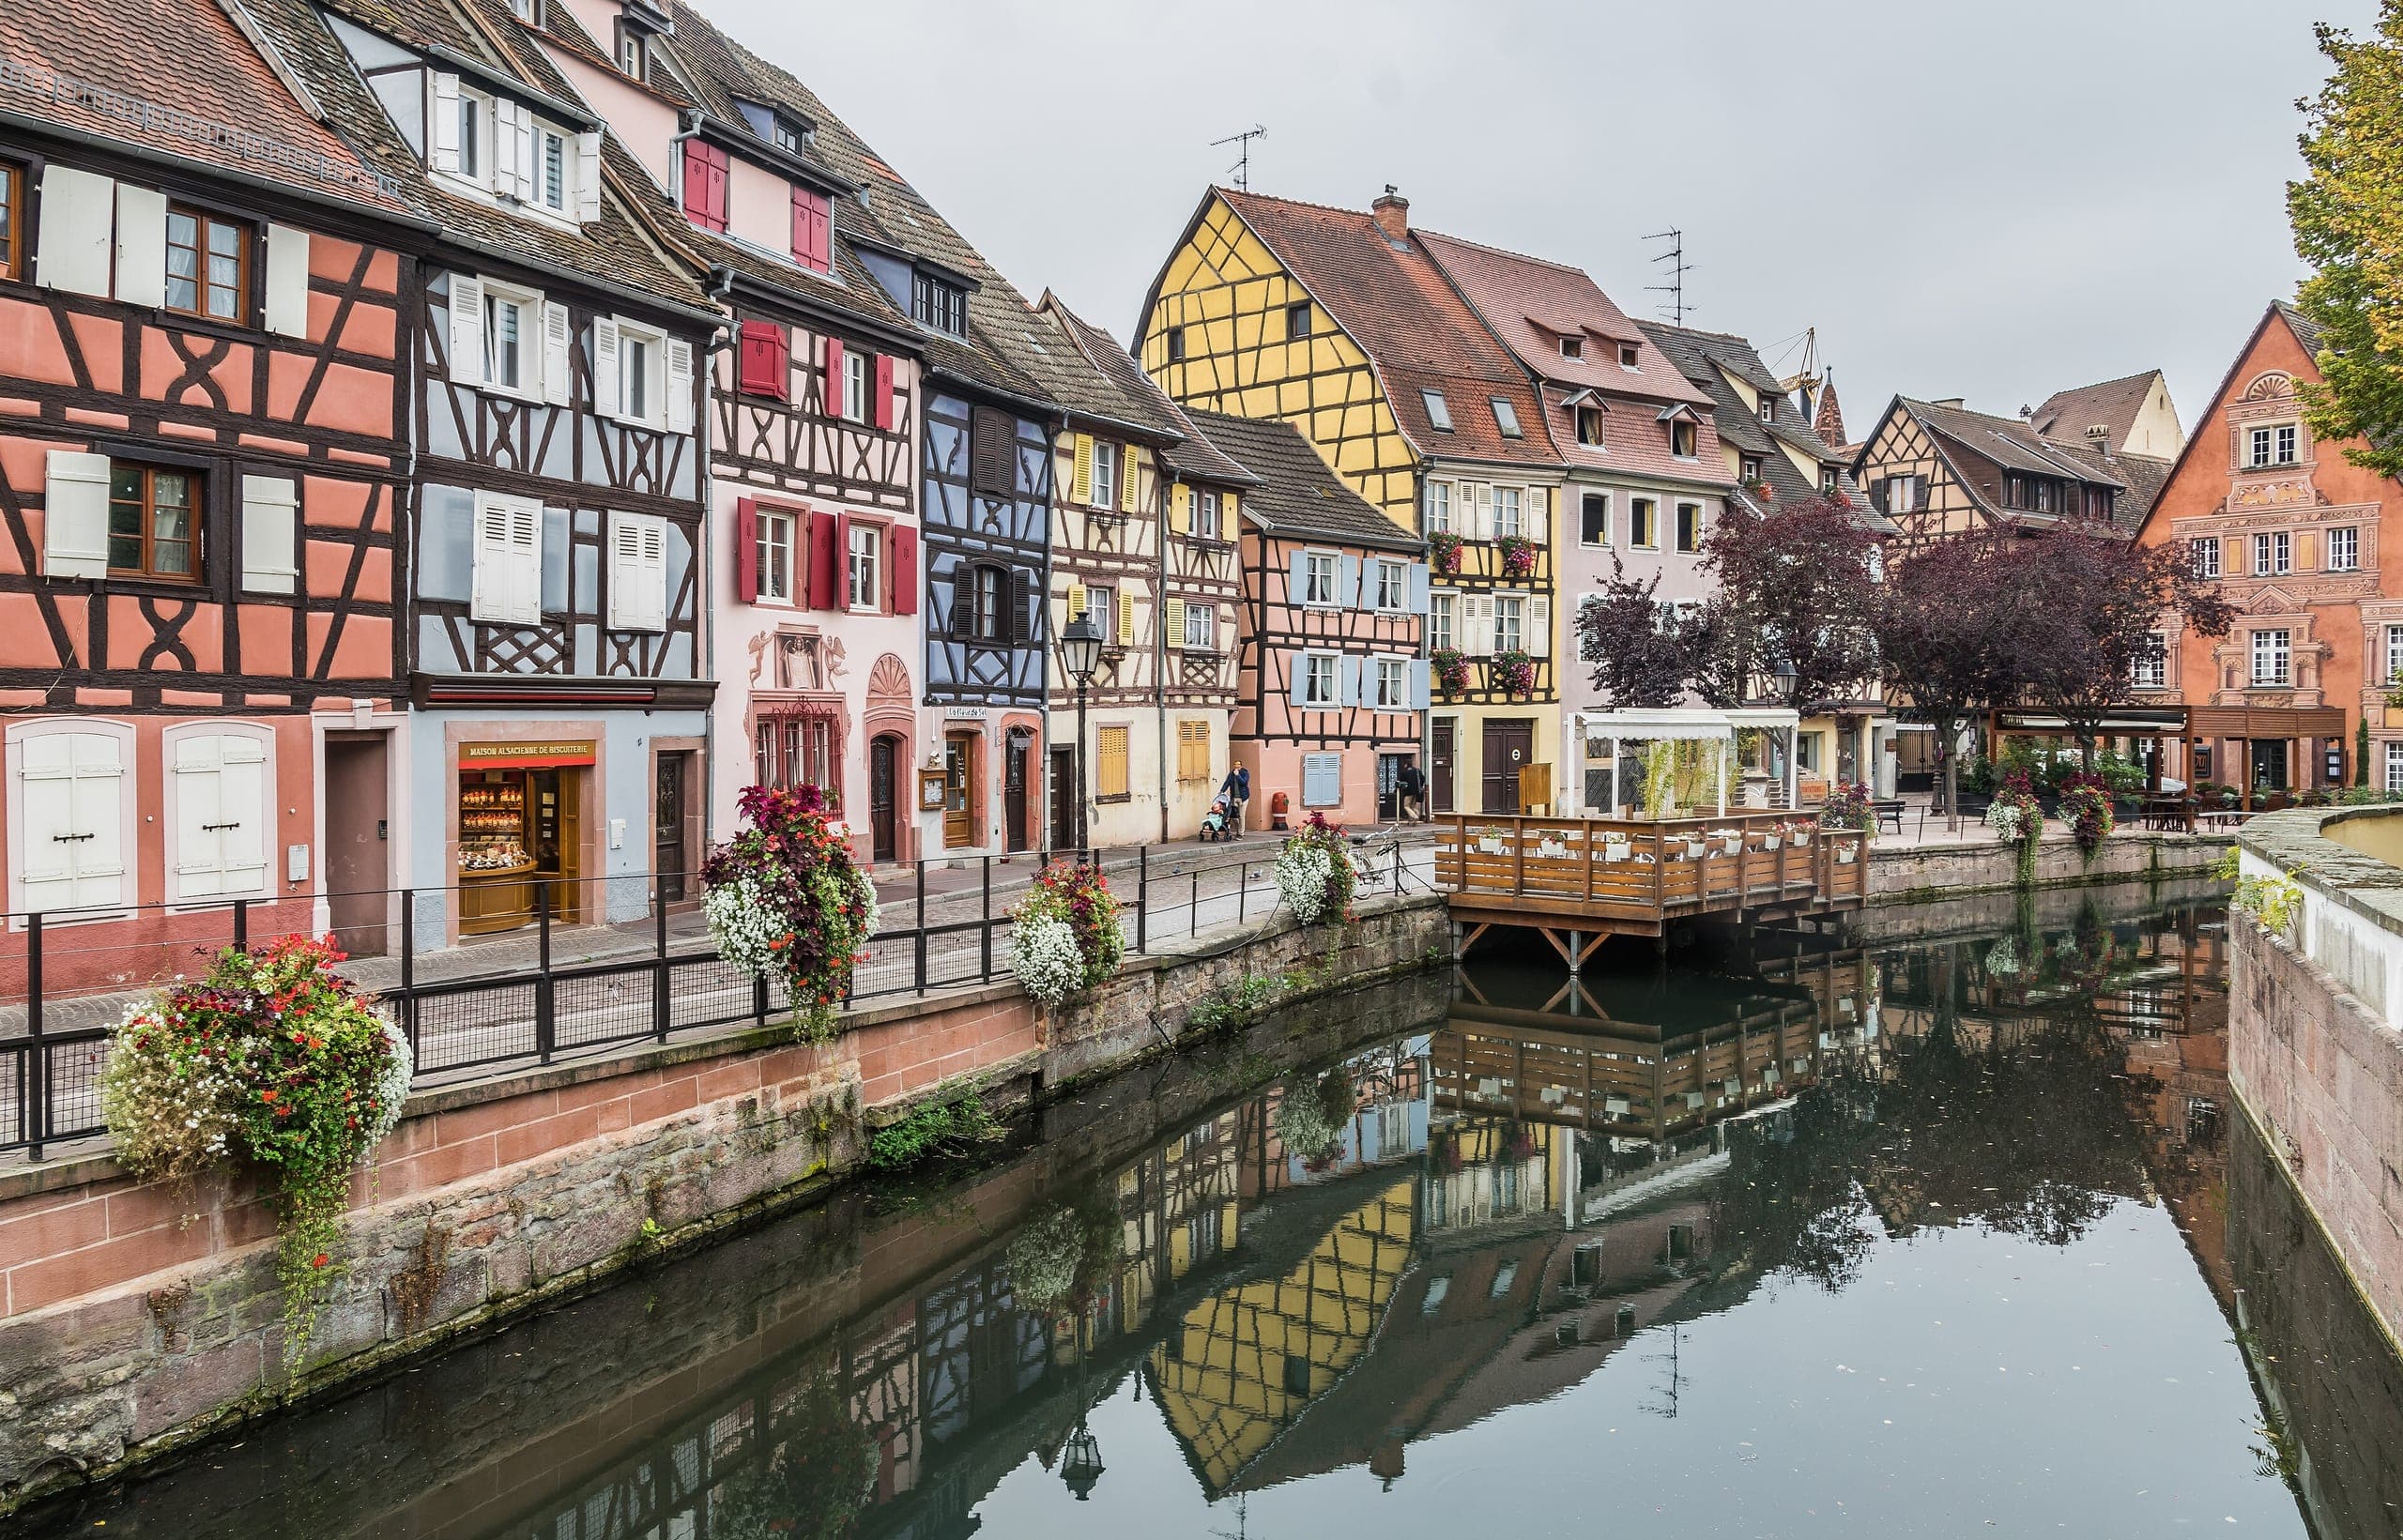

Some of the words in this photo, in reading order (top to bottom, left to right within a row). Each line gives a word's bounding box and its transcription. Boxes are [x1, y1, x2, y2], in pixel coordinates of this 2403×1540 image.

[469, 747, 497, 756] MAISON
[497, 746, 539, 755] ALSACIENNE
[539, 746, 549, 755] DE
[549, 745, 588, 754] BISCUITERIE
